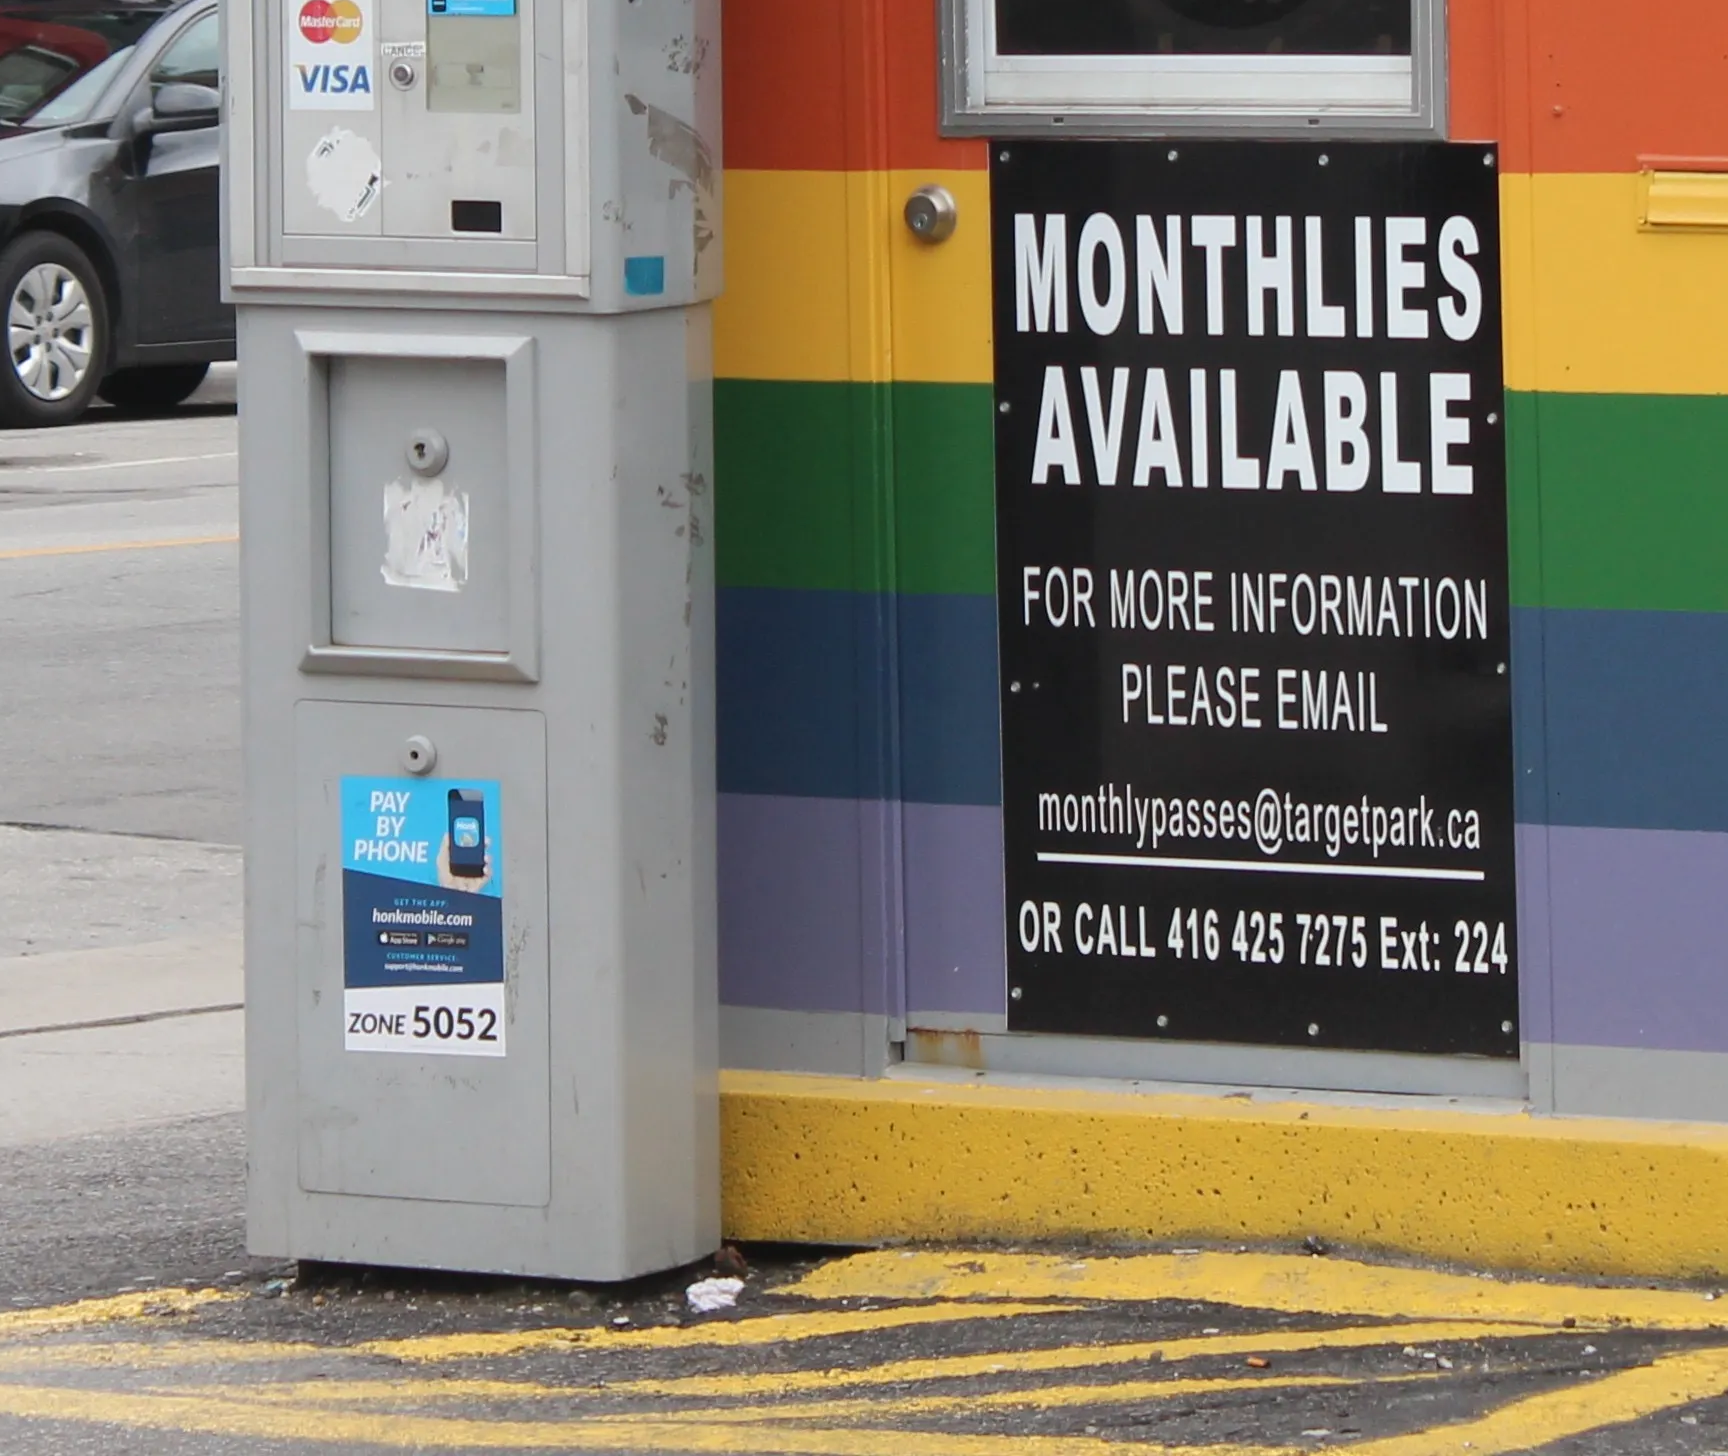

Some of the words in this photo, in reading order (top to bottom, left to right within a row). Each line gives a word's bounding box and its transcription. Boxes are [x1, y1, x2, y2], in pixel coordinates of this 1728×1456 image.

[301, 14, 360, 28] MasterCard
[294, 64, 370, 94] VISA
[1015, 212, 1482, 341] MONTHLIES
[1032, 366, 1473, 494] AVAILABLE
[1024, 566, 1095, 627] FOR
[1110, 569, 1215, 632] MORE
[1230, 573, 1487, 640] INFORMATION
[1122, 663, 1261, 728] PLEASE
[1277, 669, 1388, 732] EMAIL
[370, 791, 410, 813] PAY
[376, 816, 406, 837] BY
[1038, 784, 1480, 858] monthlypasses@targetpark.ca
[354, 840, 429, 862] PHONE
[372, 907, 472, 927] honkmobile.com
[1019, 901, 1062, 953] OR
[1074, 904, 1155, 957] CALL
[1167, 908, 1219, 961] 416
[1231, 911, 1284, 964] 425
[1296, 914, 1367, 968] 7275
[1380, 917, 1440, 971] Ext:
[1455, 921, 1507, 975] 224
[348, 1013, 406, 1034] ZONE
[413, 1006, 497, 1042] 5052
